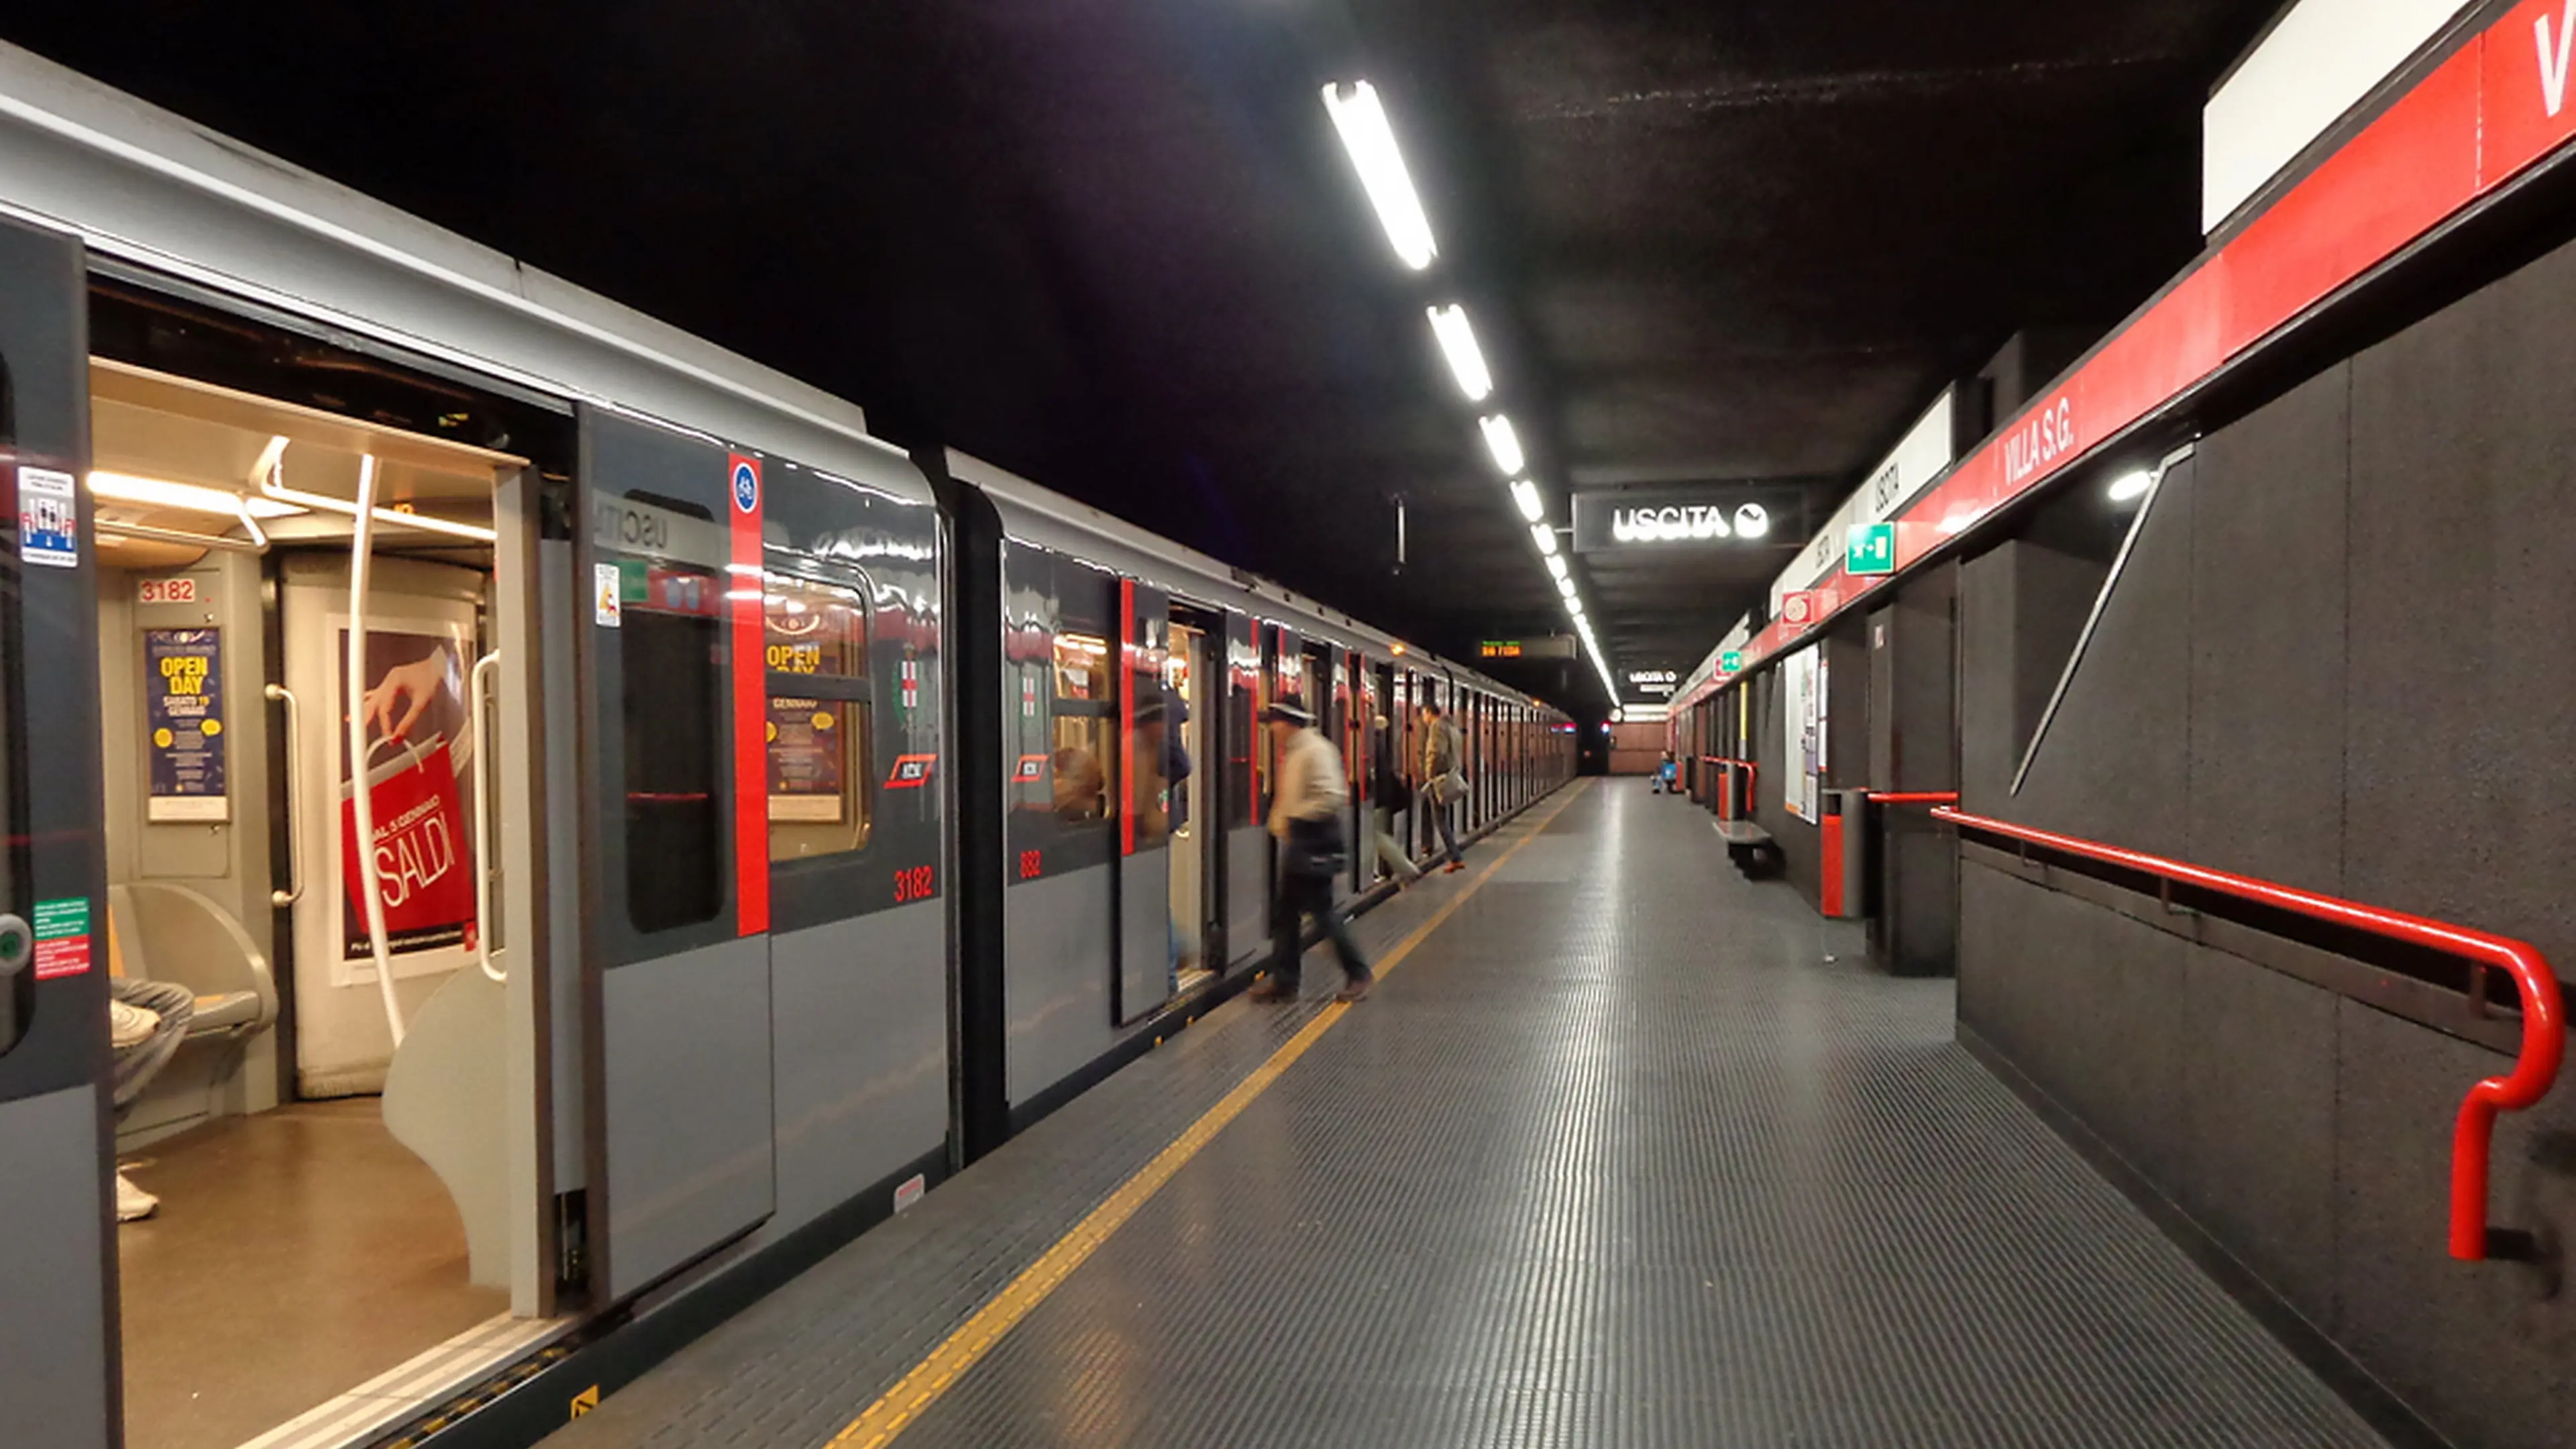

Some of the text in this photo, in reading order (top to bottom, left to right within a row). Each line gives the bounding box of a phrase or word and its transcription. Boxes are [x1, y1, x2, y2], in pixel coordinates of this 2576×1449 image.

[2004, 420, 2041, 486] VILLA
[1613, 506, 1731, 542] USCITA
[141, 580, 193, 600] 3182
[161, 656, 208, 676] OPEN
[767, 645, 820, 666] OPEN
[170, 676, 203, 695] DAY
[374, 810, 455, 907] SALDI
[894, 865, 933, 902] 3182
